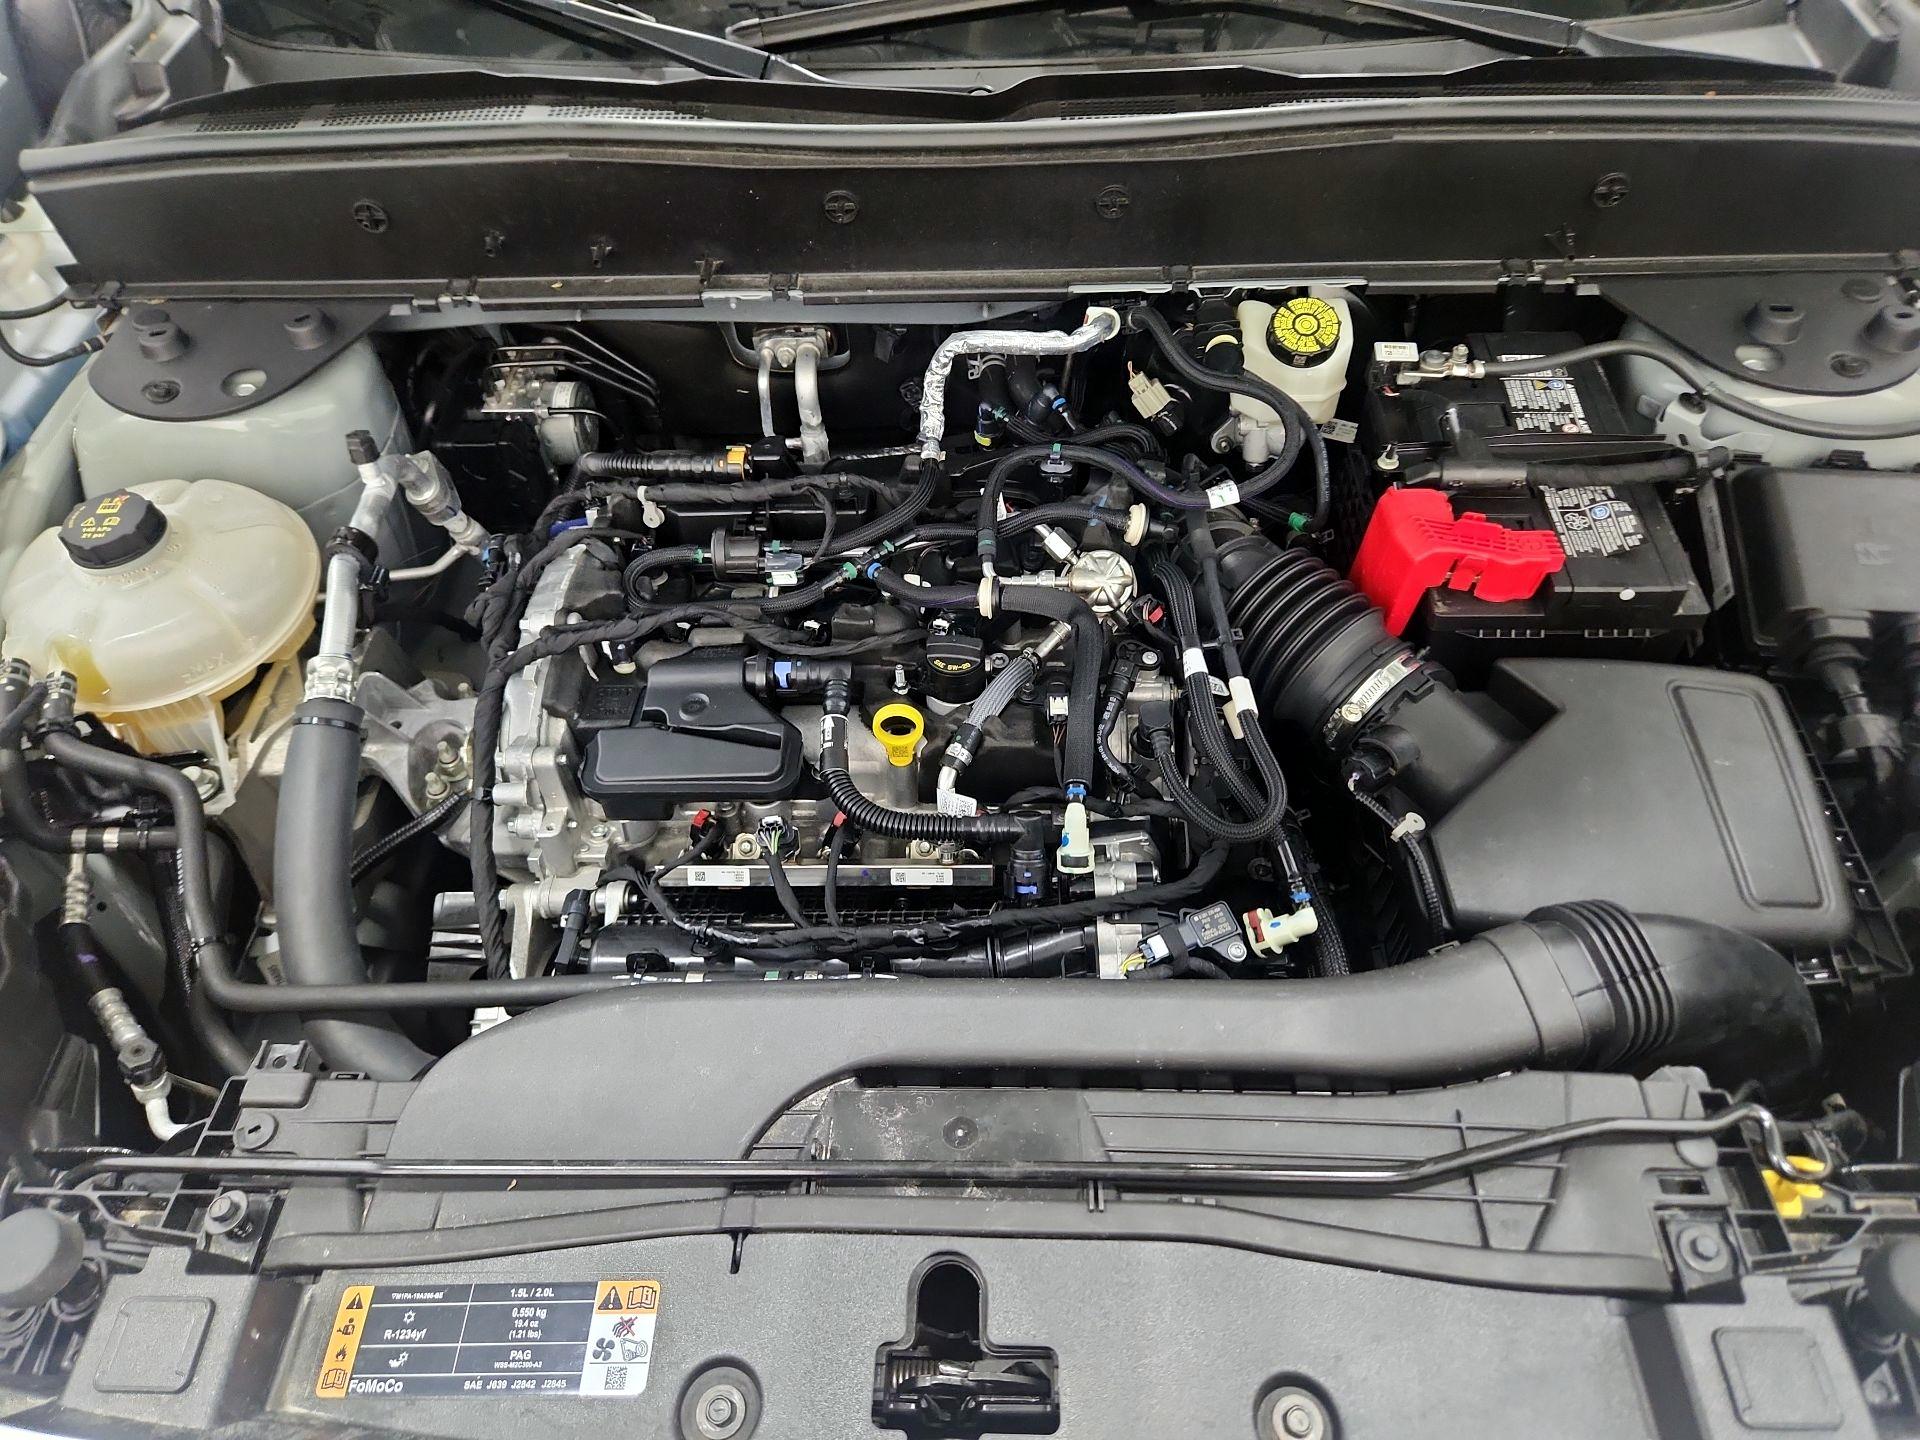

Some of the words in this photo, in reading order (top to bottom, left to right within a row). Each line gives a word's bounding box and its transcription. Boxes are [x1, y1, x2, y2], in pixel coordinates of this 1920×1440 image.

[510, 1287, 529, 1298] 1.5L
[529, 1287, 535, 1298] /
[535, 1287, 555, 1298] 2.0L
[511, 1307, 535, 1318] 0.550
[535, 1307, 548, 1320] kg
[514, 1319, 529, 1328] 19.4
[529, 1320, 539, 1328] oz
[383, 1328, 428, 1342] R-1234yf
[508, 1329, 526, 1341] (1.21
[509, 1349, 532, 1361] PAG
[348, 1378, 403, 1393] FoMoCo
[510, 1379, 537, 1390] J2842
[541, 1379, 567, 1390] J2845
